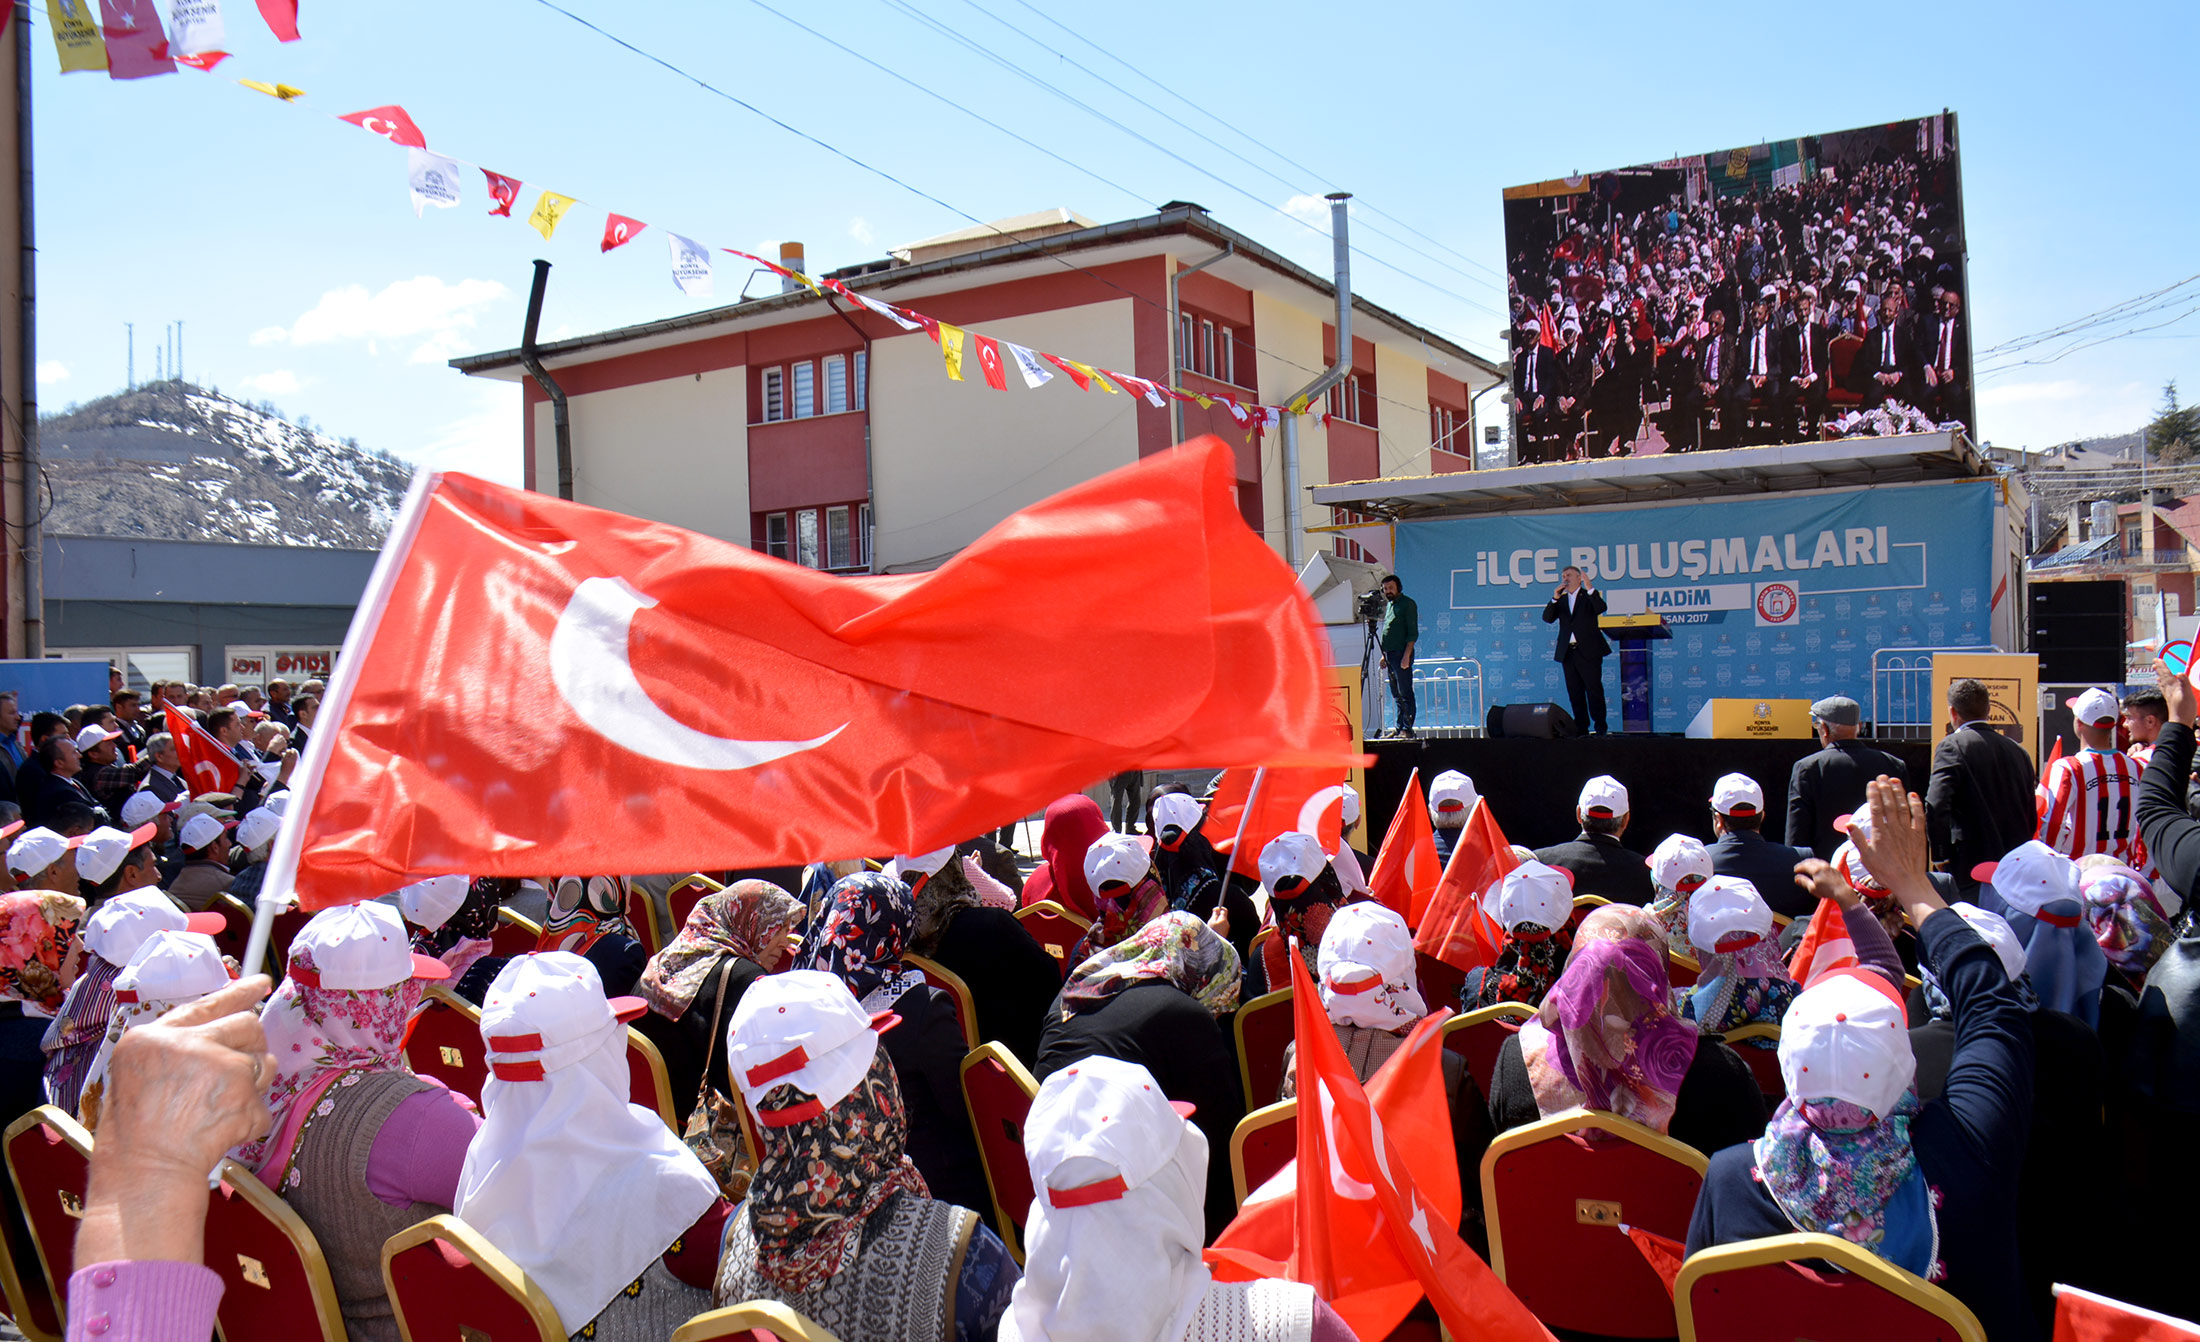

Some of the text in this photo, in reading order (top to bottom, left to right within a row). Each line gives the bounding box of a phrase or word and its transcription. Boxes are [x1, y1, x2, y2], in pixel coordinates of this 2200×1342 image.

[1571, 526, 1889, 582] BULUŞMALARI
[1662, 613, 1709, 624] SAN 2017
[2096, 796, 2130, 841] 11
